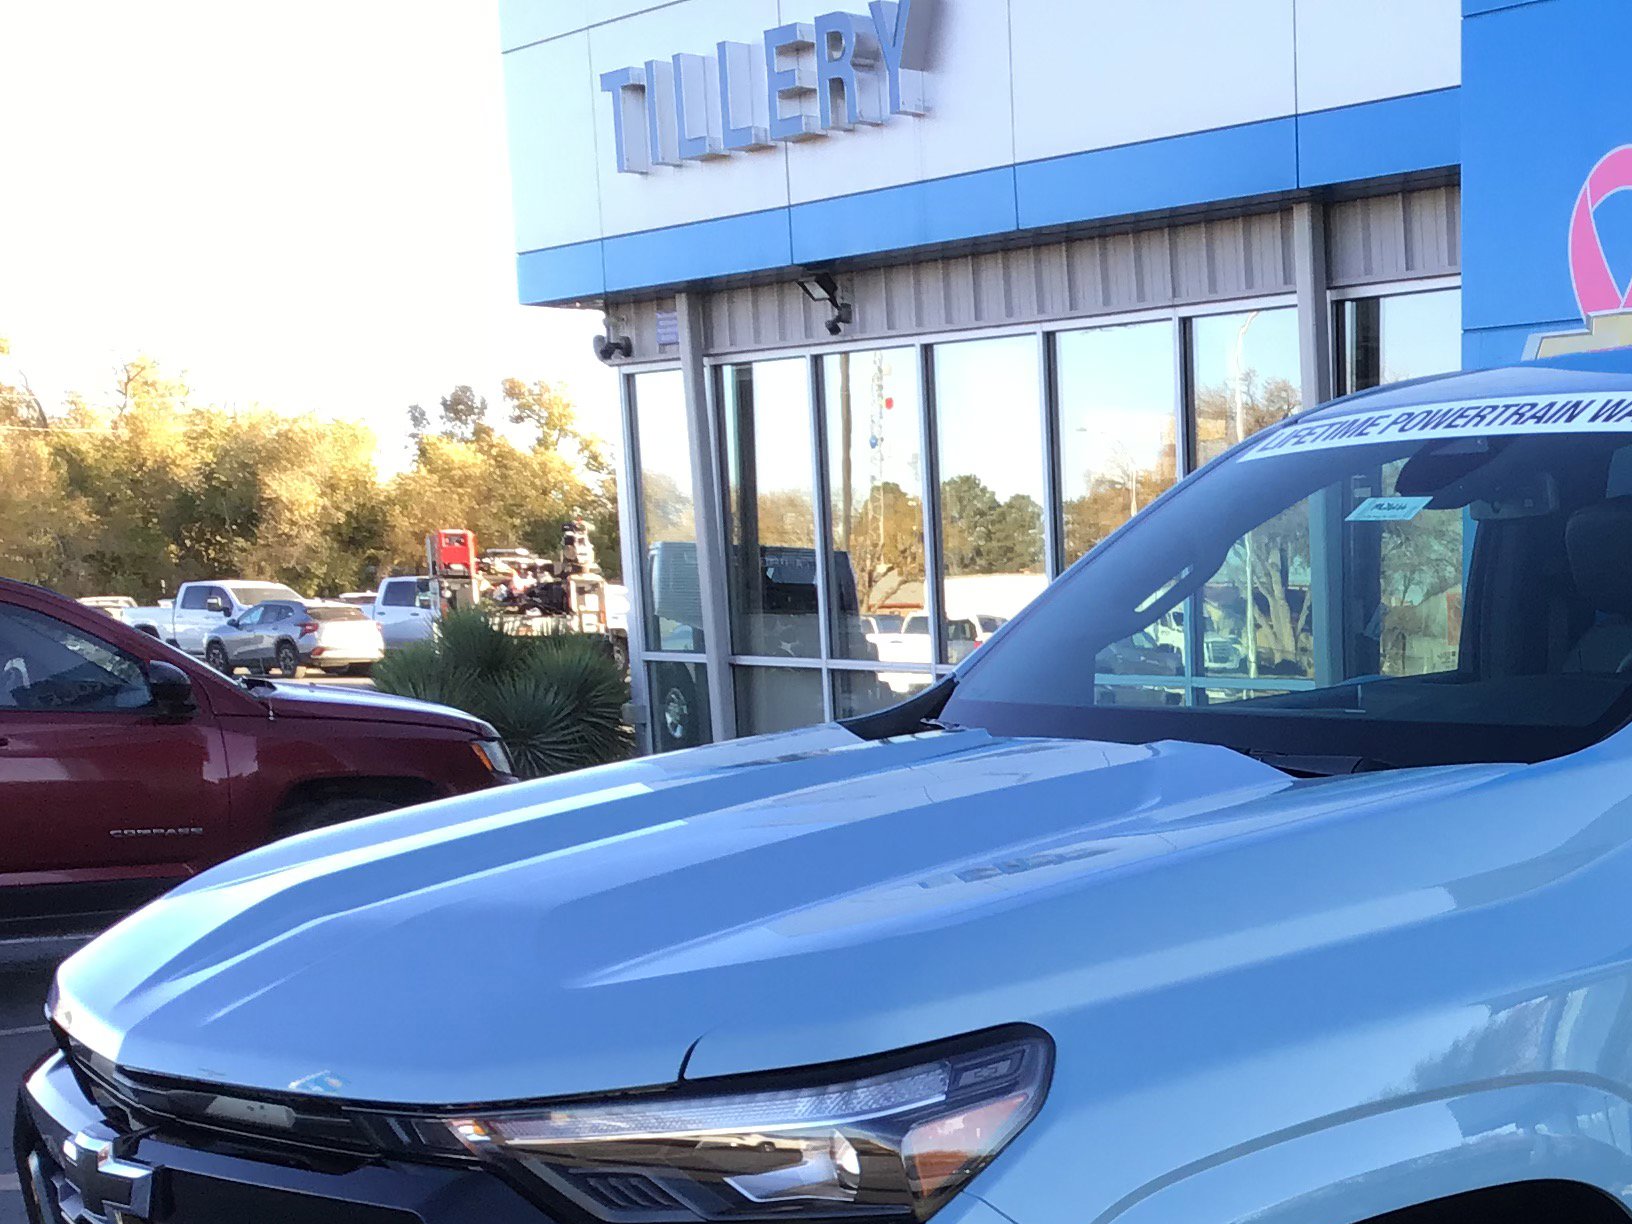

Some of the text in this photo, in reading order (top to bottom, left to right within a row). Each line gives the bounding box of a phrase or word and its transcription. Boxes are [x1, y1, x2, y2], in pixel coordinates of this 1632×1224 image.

[600, 0, 914, 174] TILLERY
[1257, 414, 1393, 452] LIFETIME
[1377, 399, 1597, 436] POWERTRAIN
[109, 827, 203, 838] COMPASS
